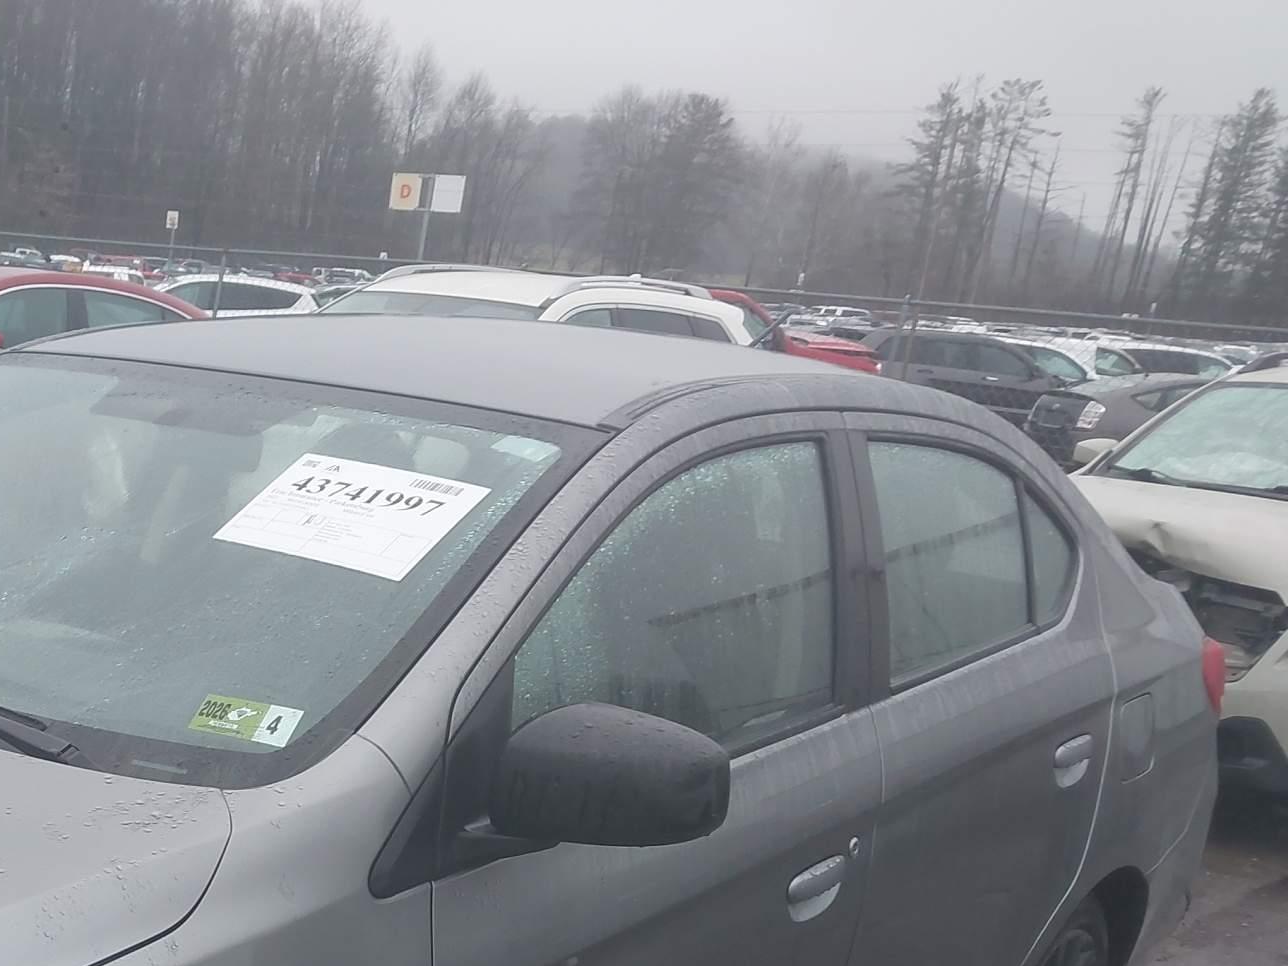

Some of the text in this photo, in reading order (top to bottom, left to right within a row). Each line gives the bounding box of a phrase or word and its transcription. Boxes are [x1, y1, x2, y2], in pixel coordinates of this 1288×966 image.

[400, 184, 413, 199] D
[291, 476, 446, 516] 43741997
[198, 700, 232, 720] 2026
[265, 715, 283, 735] 4
